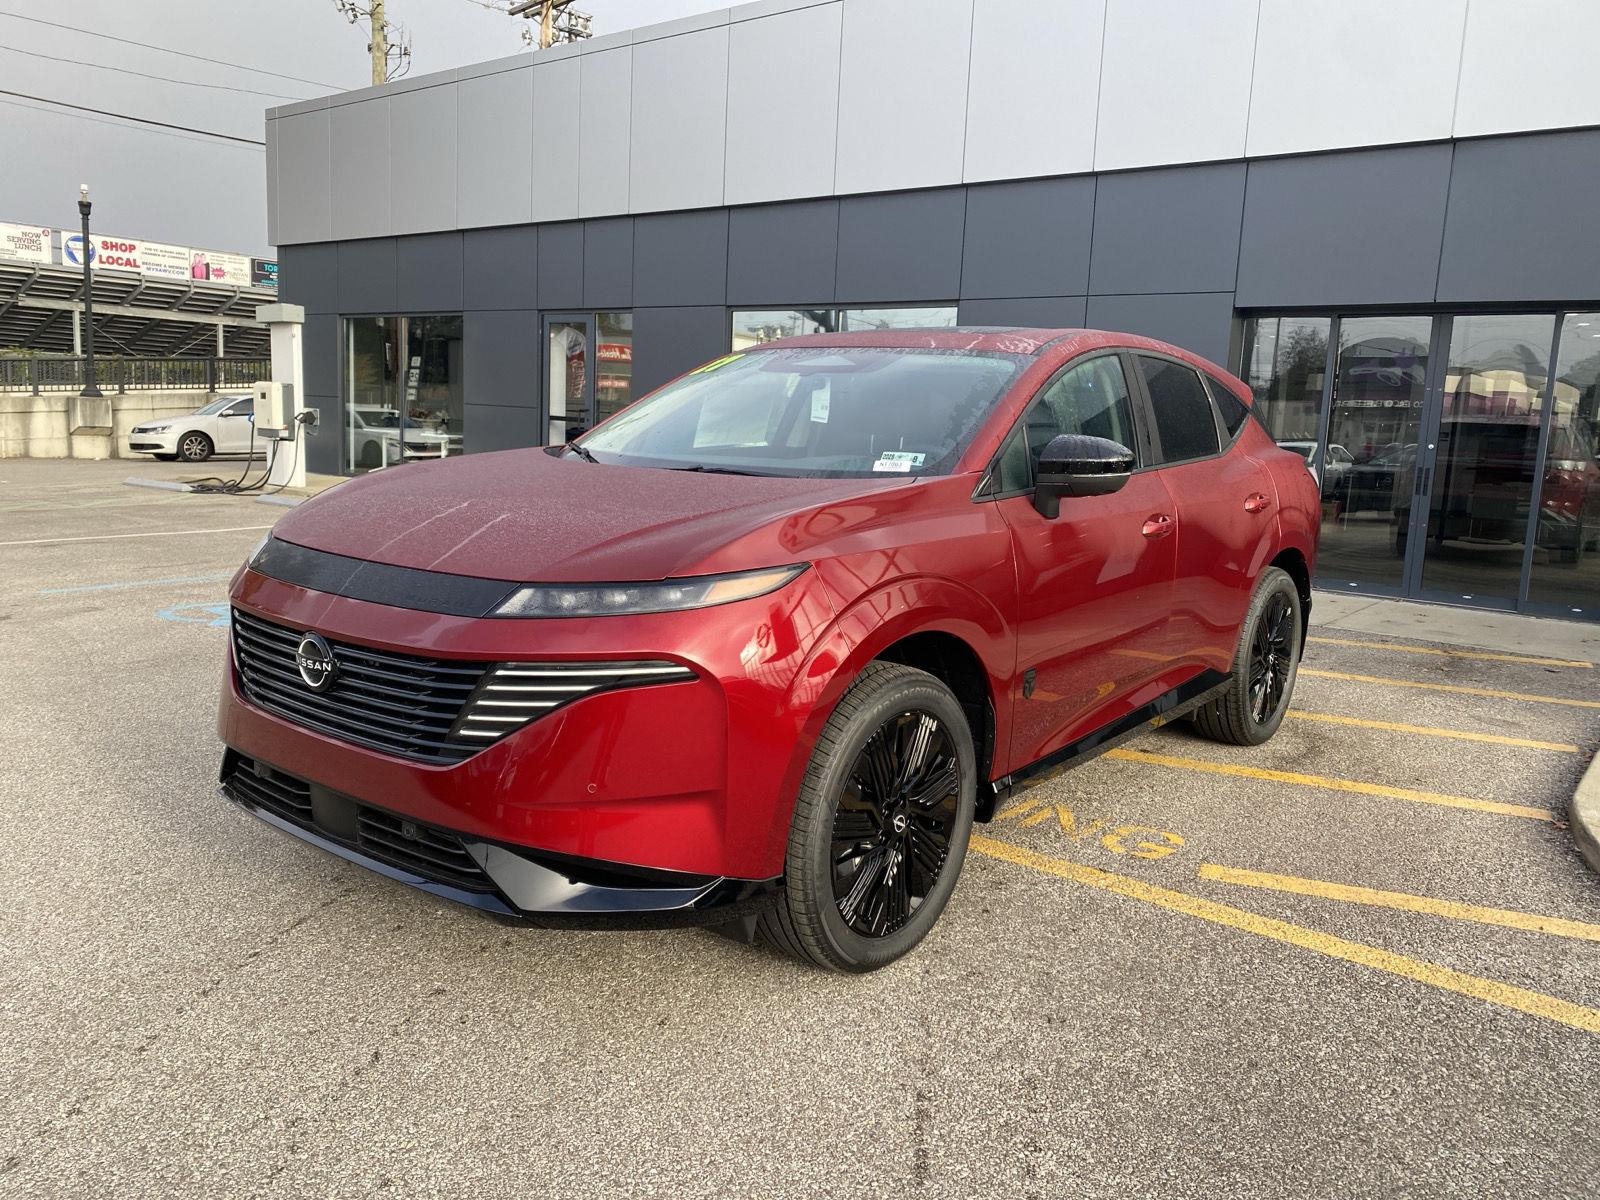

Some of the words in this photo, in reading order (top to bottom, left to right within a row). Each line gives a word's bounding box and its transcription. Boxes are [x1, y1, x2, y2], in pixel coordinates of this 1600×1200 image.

[21, 231, 41, 239] NOW
[6, 236, 42, 245] SERVING
[14, 243, 42, 252] LUNCH
[101, 240, 136, 253] SHOP
[98, 254, 141, 268] LOCAL
[141, 260, 162, 268] BECOME
[145, 266, 185, 276] MYSAWV.COM
[296, 653, 332, 671] NISSAN
